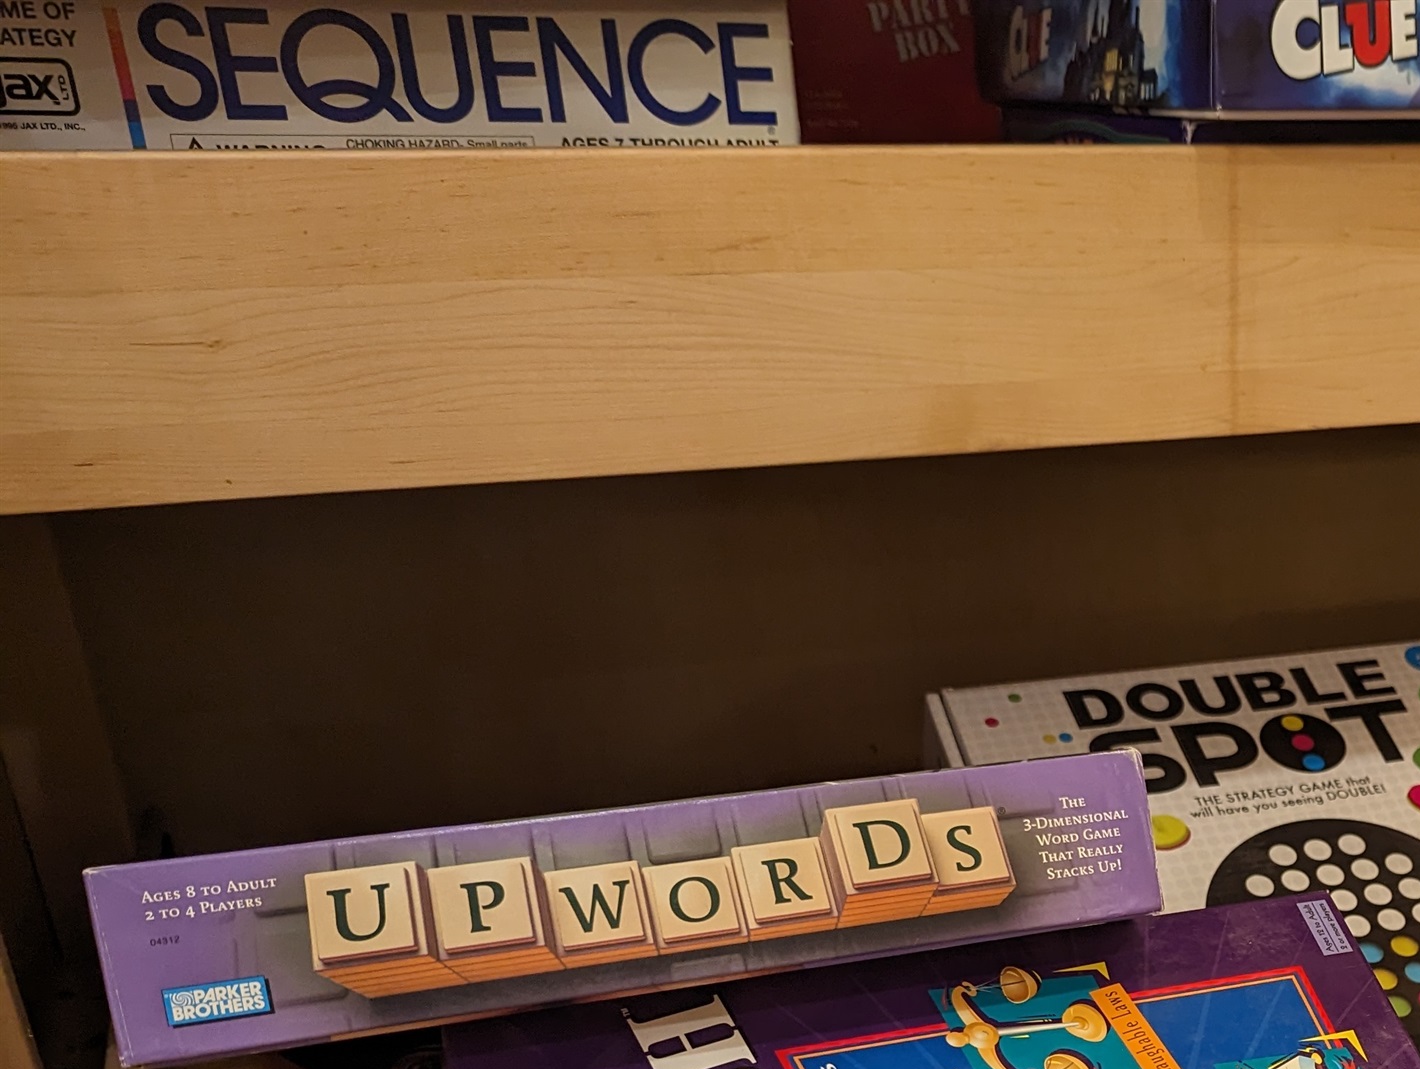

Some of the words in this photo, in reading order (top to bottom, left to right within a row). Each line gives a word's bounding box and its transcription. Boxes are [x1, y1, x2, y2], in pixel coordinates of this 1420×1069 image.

[43, 1, 75, 20] OF
[894, 21, 961, 64] BOX
[1270, 0, 1419, 81] CLUE
[136, 1, 778, 126] SEQUENCE
[20, 122, 38, 130] JAX
[346, 138, 404, 149] CHOKING
[1062, 658, 1398, 732] DOUBLE
[1088, 698, 1409, 795] SPOT
[1058, 796, 1087, 810] THE
[1190, 806, 1214, 819] will
[1216, 804, 1249, 817] have
[1253, 800, 1279, 814] you
[1282, 793, 1325, 807] seeing
[1326, 783, 1388, 801] DOUBLE!
[1194, 795, 1222, 807] THE
[1227, 785, 1294, 804] STRATEGY
[1299, 779, 1343, 794] GAME
[1346, 776, 1371, 788] that
[1022, 808, 1129, 832] 3-DIMENSIONAL
[1035, 830, 1080, 847] WORD
[1082, 826, 1121, 842] GAME
[1038, 848, 1075, 865] THAT
[1077, 842, 1124, 861] REALLY
[326, 818, 986, 942] UPWORDS
[1046, 864, 1095, 881] STACKS
[1097, 857, 1123, 876] UP!
[141, 889, 181, 905] AGES
[185, 884, 197, 898] 8
[201, 882, 223, 896] TO
[226, 875, 277, 893] ADULT
[145, 908, 155, 921] 2
[159, 906, 181, 920] TO
[185, 904, 196, 920] 4
[200, 894, 263, 915] PLAYERS
[149, 934, 181, 947] 04312
[192, 980, 263, 1005] PARKER
[1105, 990, 1132, 1020] Laws
[172, 993, 266, 1023] BROTHERS
